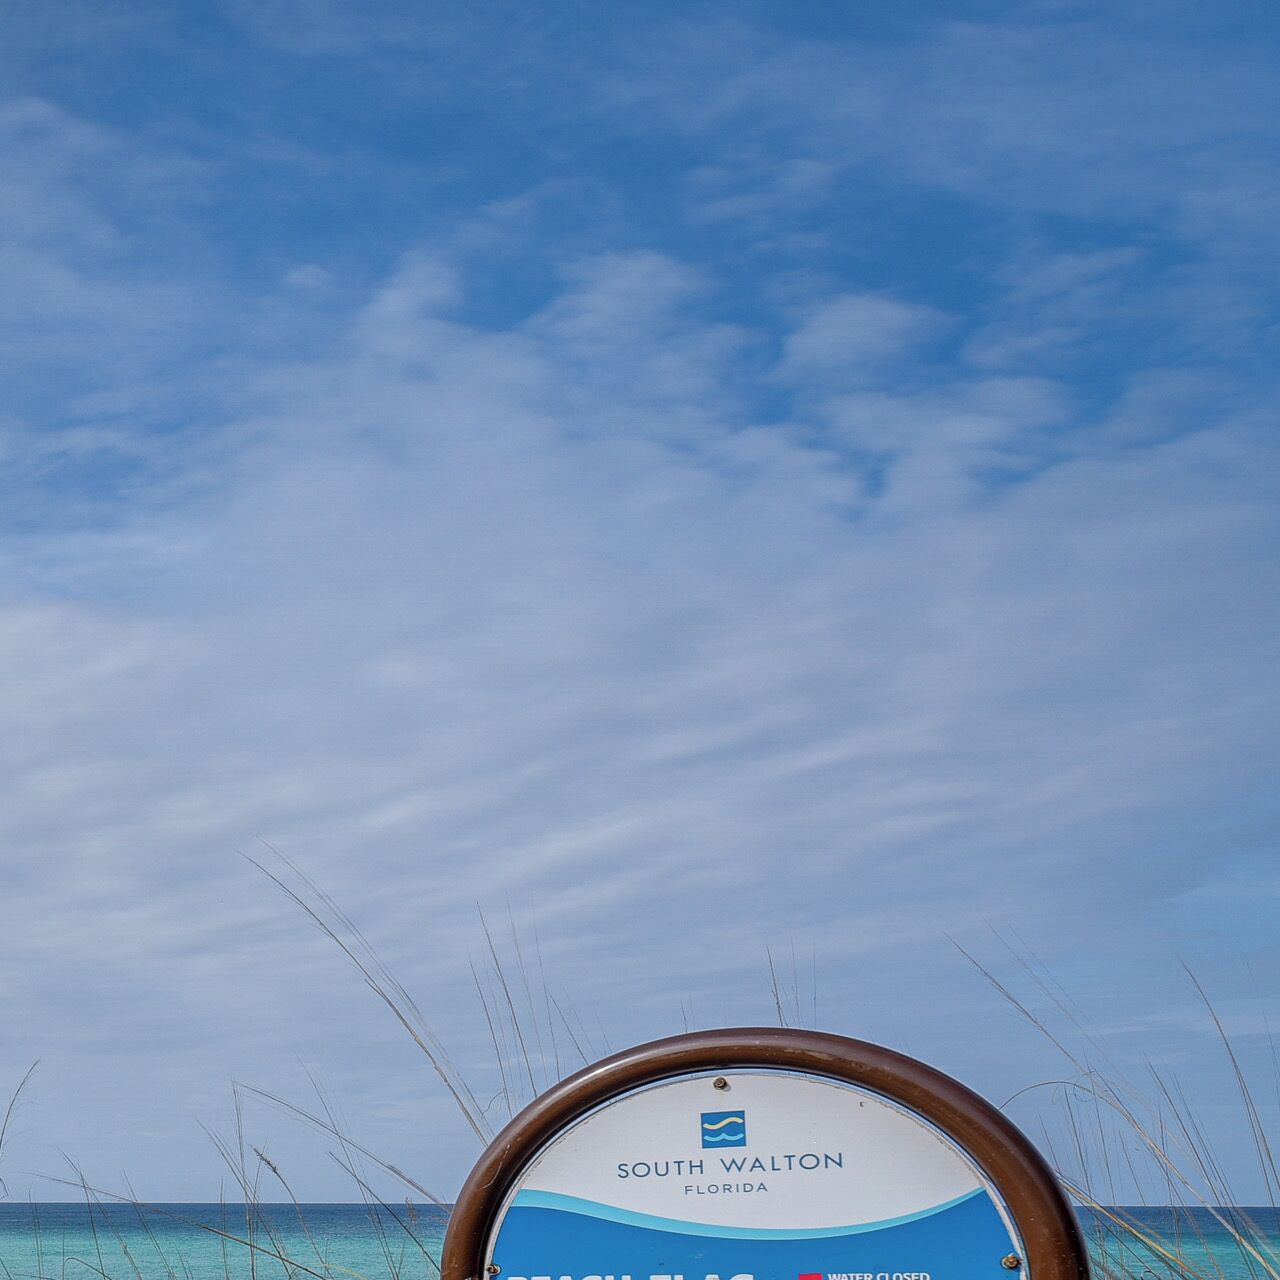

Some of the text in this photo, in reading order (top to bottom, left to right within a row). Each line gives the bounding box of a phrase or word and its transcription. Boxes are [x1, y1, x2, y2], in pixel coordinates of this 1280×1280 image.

[617, 1153, 843, 1178] SOUTH WALTON
[685, 1183, 768, 1195] FLORIDA
